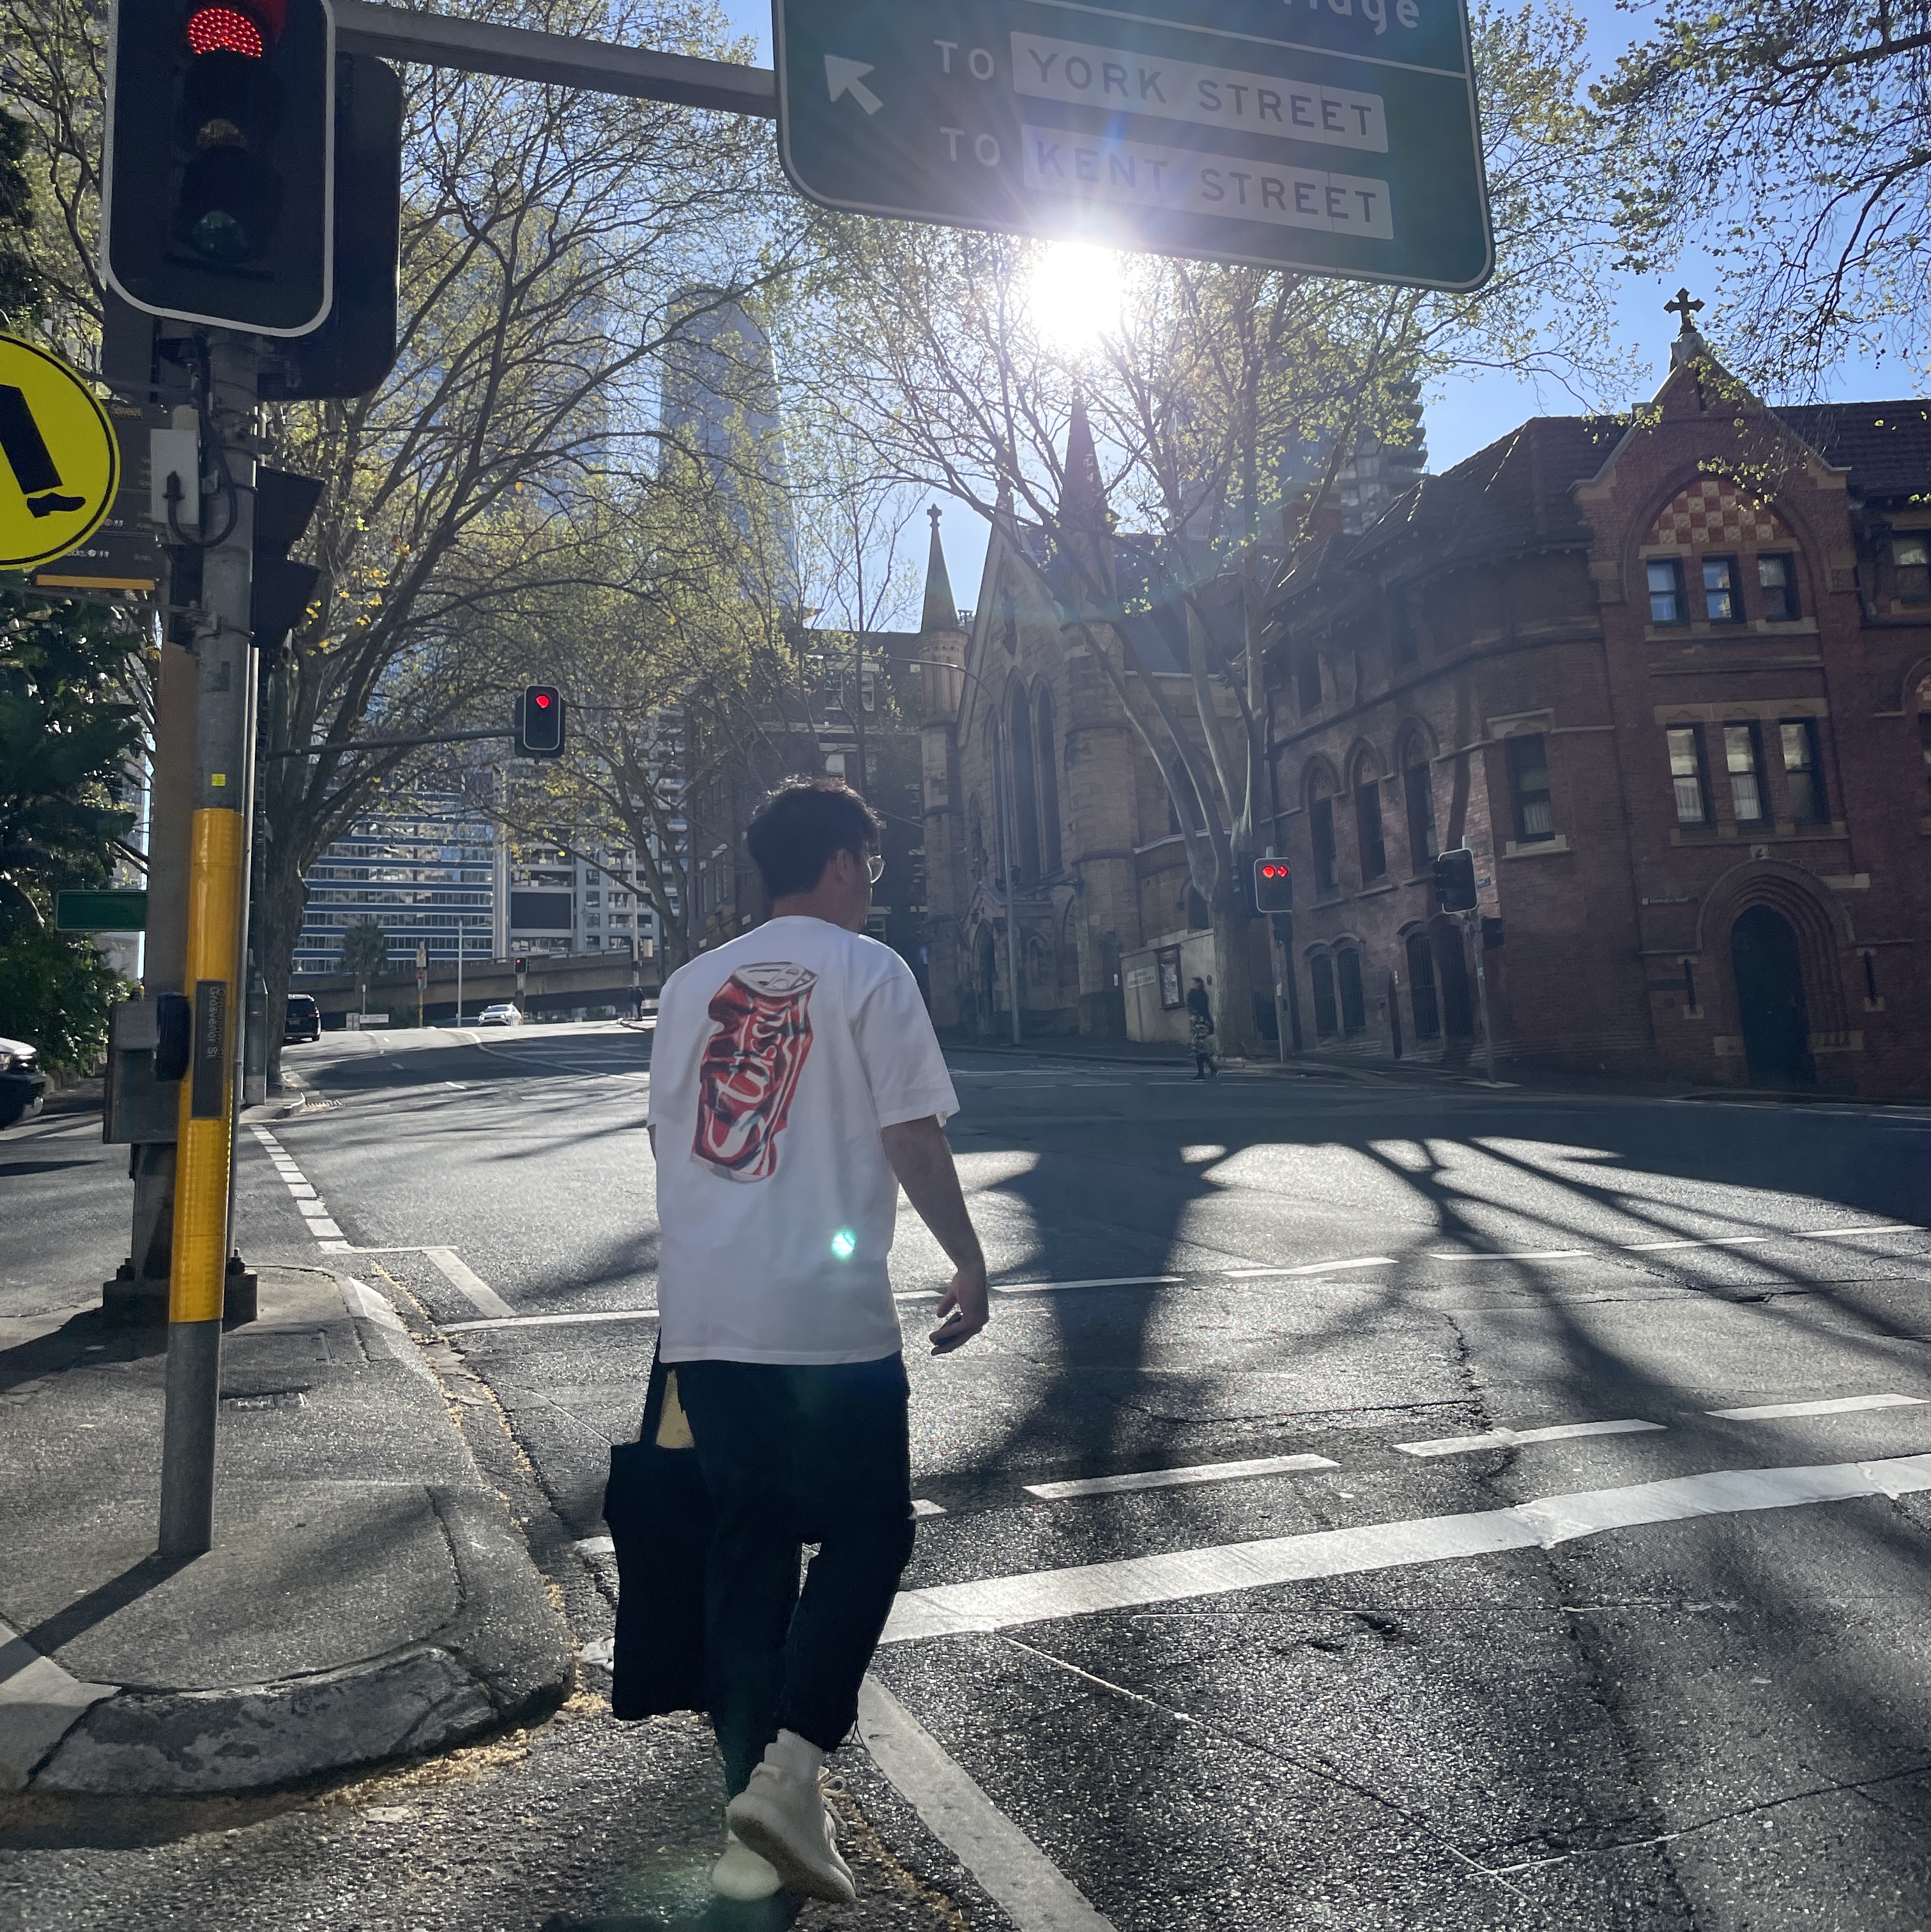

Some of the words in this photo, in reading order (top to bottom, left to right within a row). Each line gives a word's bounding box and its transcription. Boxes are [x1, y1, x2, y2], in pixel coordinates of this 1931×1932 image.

[933, 38, 995, 80] TO
[1027, 48, 1167, 105] YORK
[1197, 79, 1373, 136] STREET
[940, 127, 1002, 168] TO
[1036, 141, 1168, 192] KENT
[1200, 168, 1377, 224] STREET
